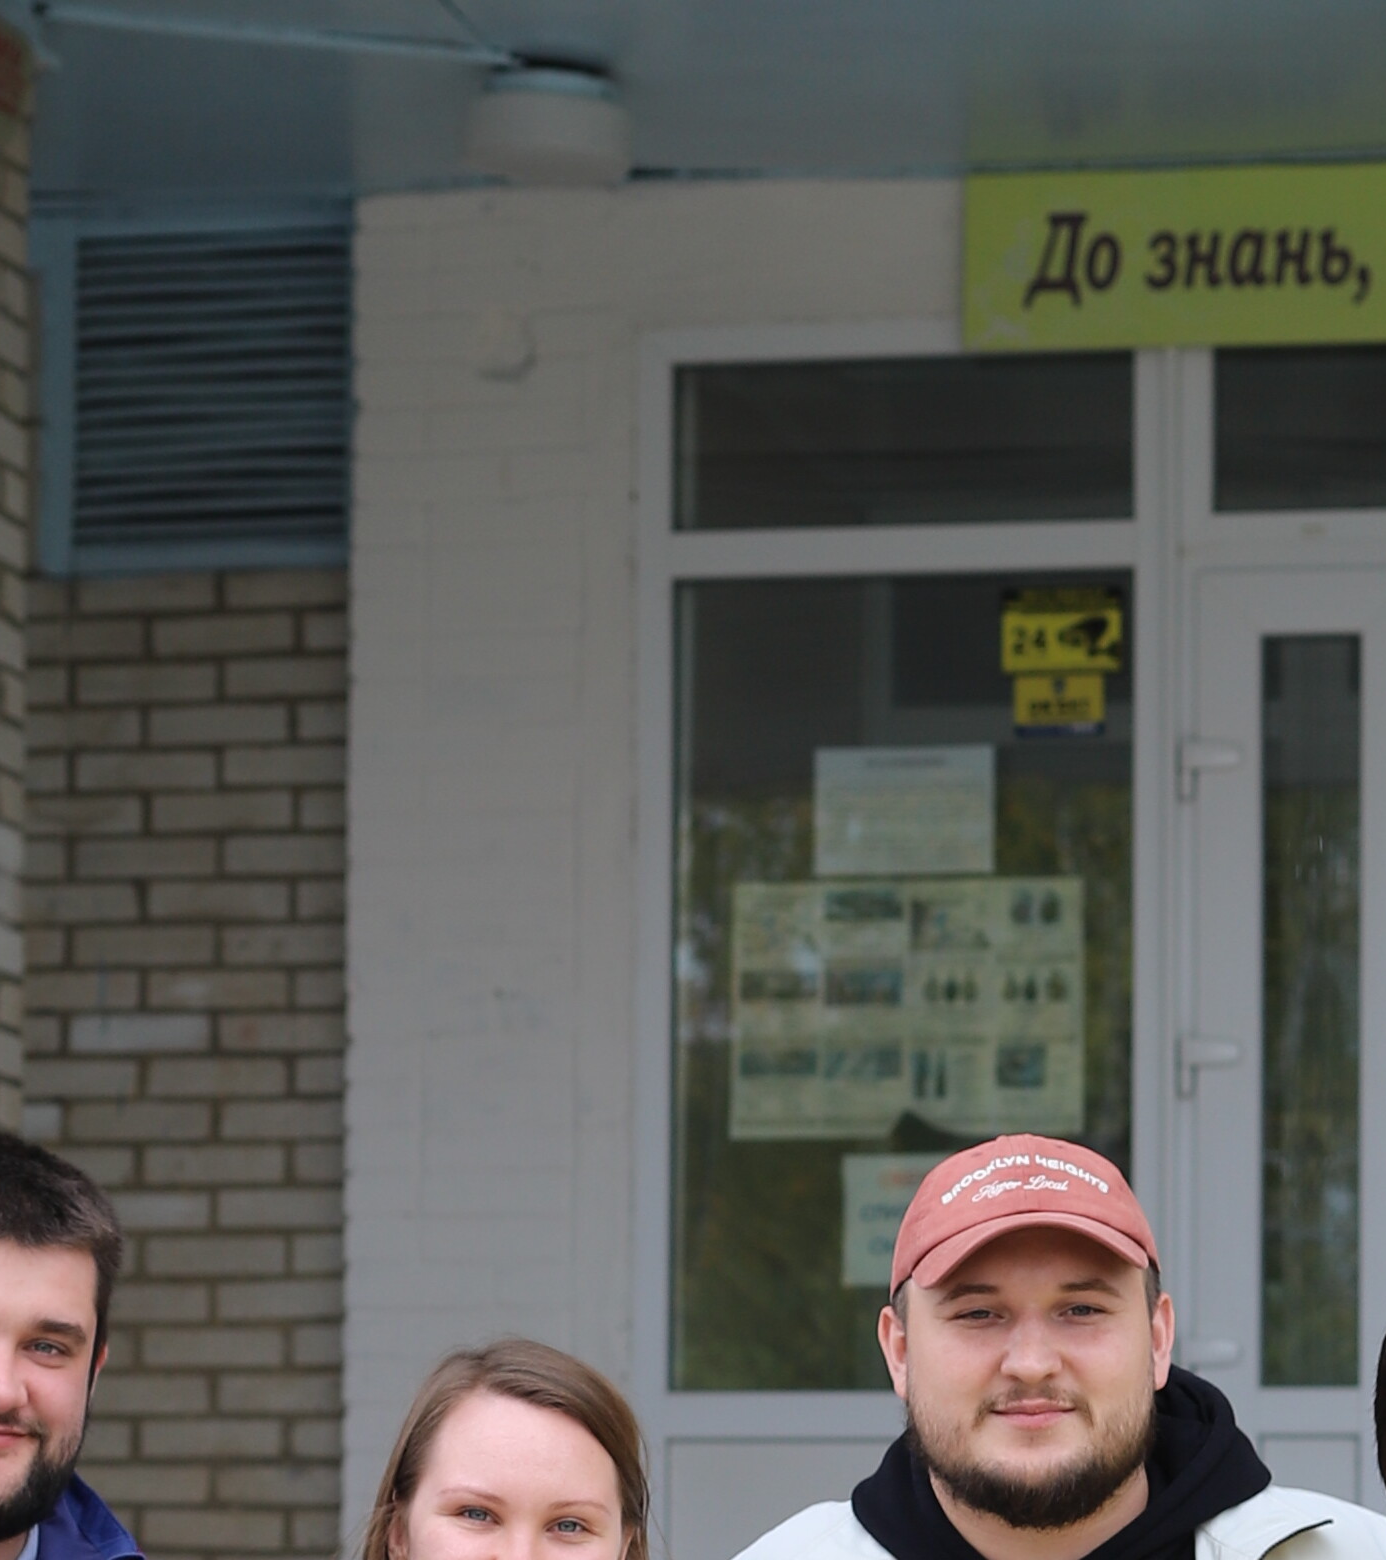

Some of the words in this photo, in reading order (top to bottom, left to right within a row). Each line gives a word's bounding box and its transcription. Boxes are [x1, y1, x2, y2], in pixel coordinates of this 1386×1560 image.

[1023, 210, 1122, 308] До
[1145, 225, 1373, 304] знань,
[941, 1154, 1030, 1205] BROOKLYN
[1035, 1154, 1110, 1193] HEIGHTS
[1023, 1175, 1069, 1191] Local
